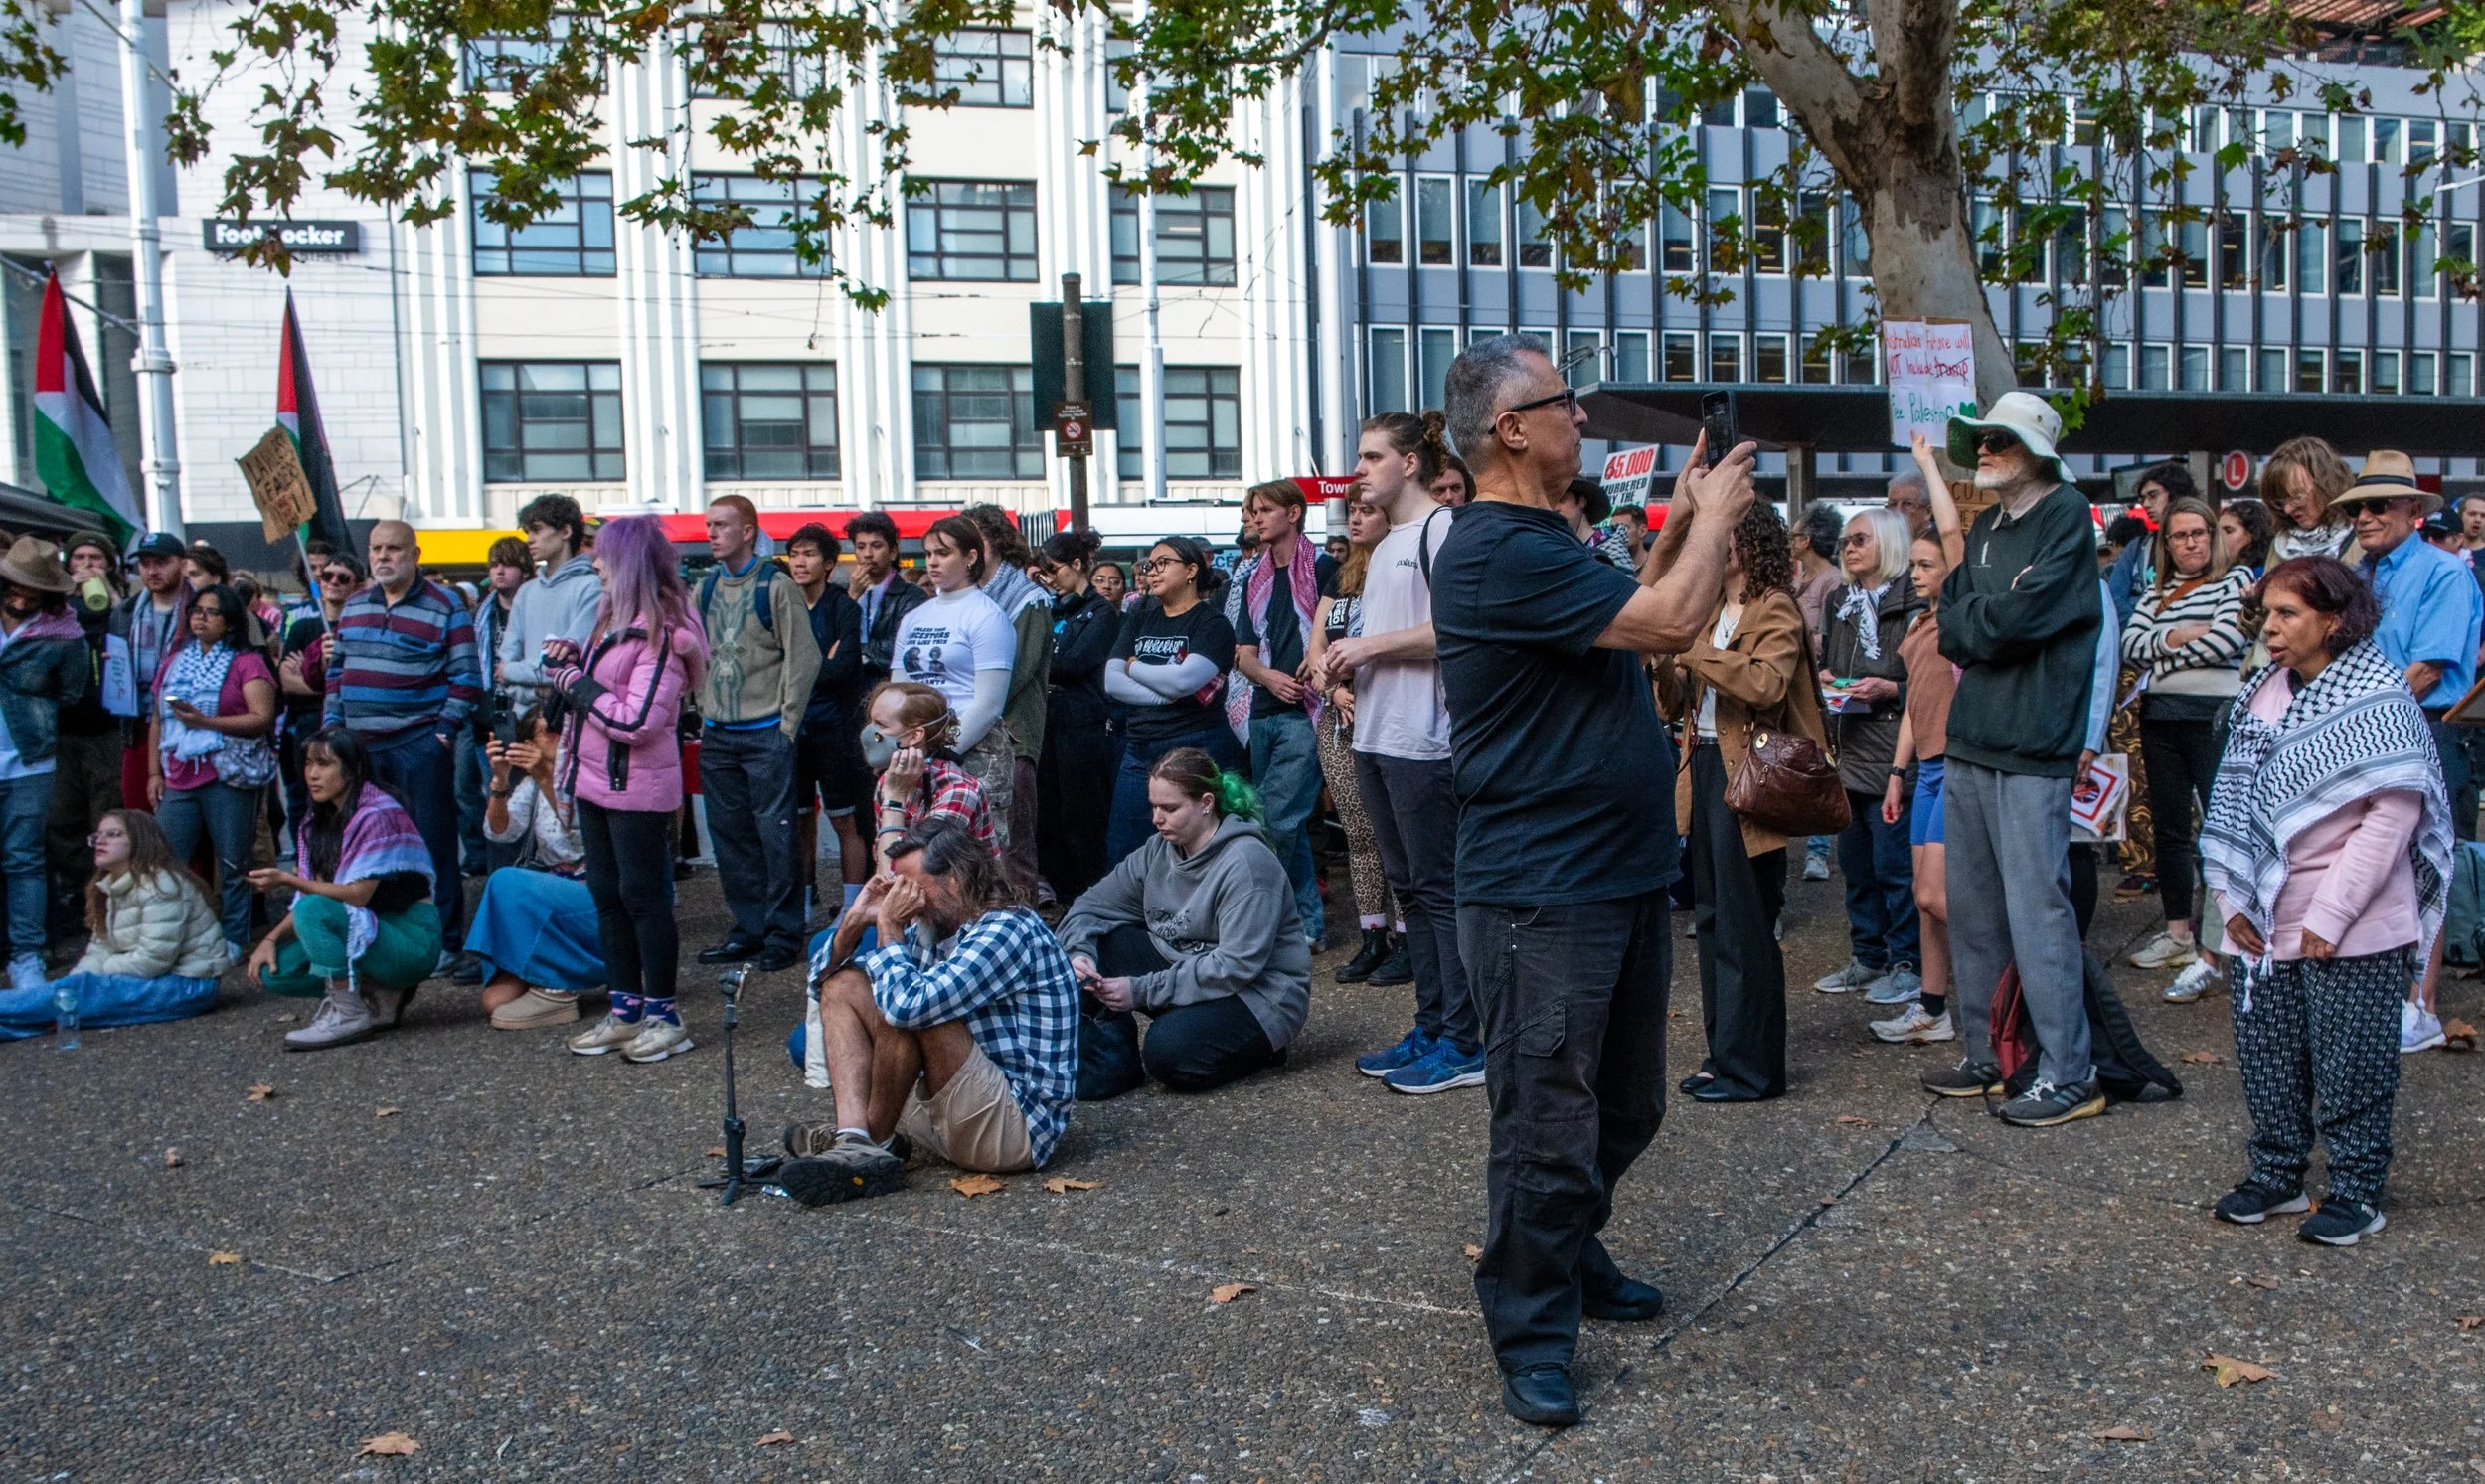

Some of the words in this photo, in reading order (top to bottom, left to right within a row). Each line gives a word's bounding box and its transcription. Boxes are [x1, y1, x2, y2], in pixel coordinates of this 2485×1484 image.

[215, 223, 263, 244] Foot
[269, 224, 345, 245] ocker
[2231, 458, 2241, 481] L
[1620, 491, 1636, 504] THE
